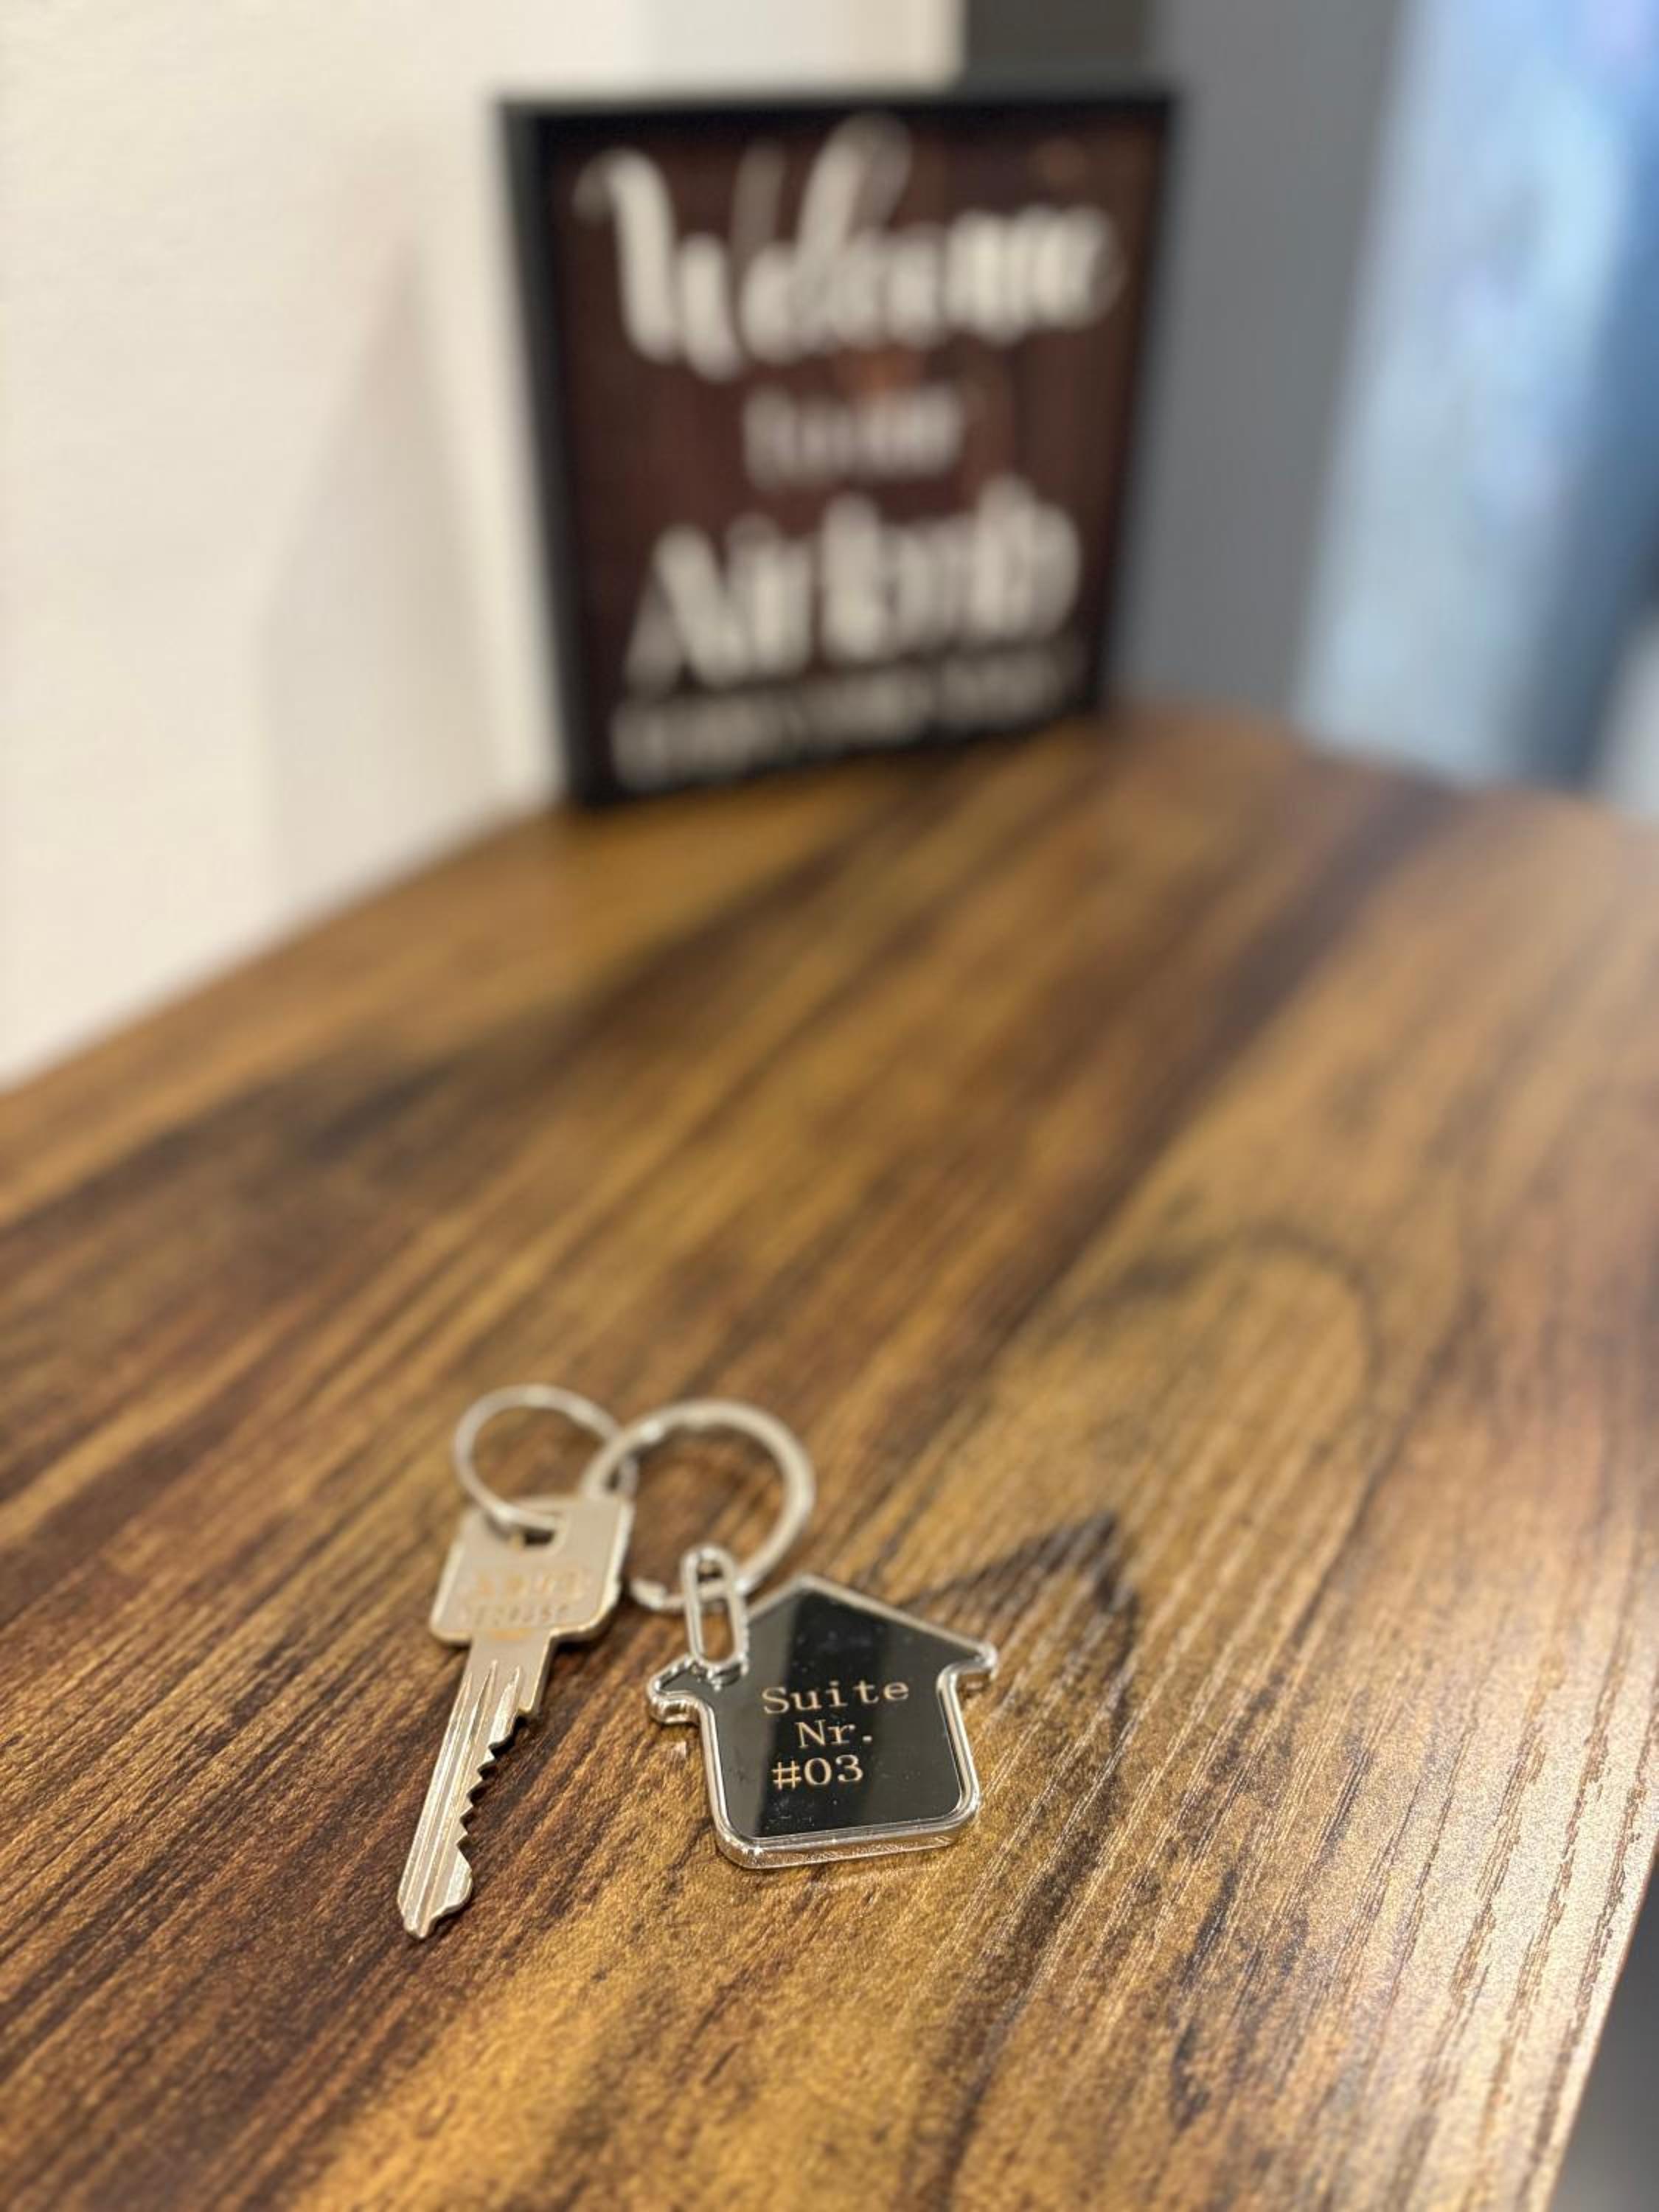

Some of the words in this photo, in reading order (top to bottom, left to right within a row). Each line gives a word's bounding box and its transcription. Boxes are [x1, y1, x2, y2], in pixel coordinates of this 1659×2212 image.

[761, 1680, 909, 1715] Suite
[794, 1719, 873, 1749] Nr.
[771, 1753, 863, 1790] #03
